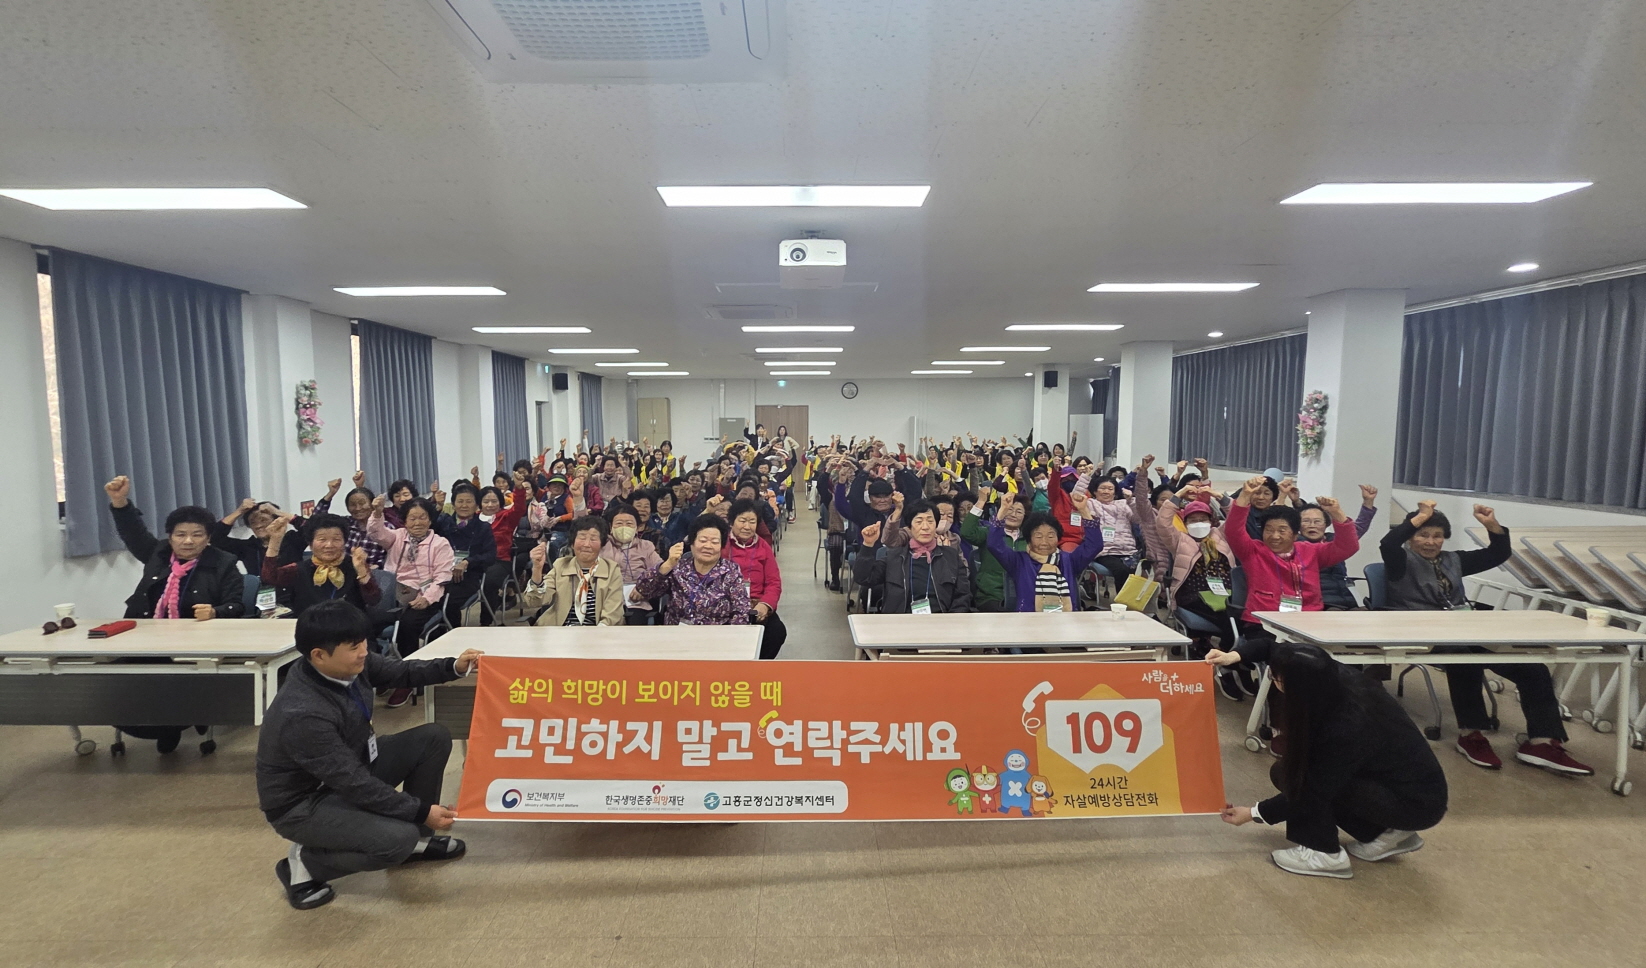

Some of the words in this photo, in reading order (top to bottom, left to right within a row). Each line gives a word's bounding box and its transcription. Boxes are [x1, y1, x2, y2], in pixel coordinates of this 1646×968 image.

[1141, 669, 1168, 684] 사람을
[508, 677, 553, 704] 삶의
[561, 679, 627, 706] 희망이
[634, 680, 701, 706] 보이지
[710, 681, 753, 708] 않을
[760, 681, 782, 706] 때
[1159, 679, 1205, 696] 더하세요
[1066, 710, 1143, 754] 109
[494, 717, 662, 764] 고민하지
[676, 719, 754, 767] 말고
[765, 719, 961, 767] 연락주세요
[1089, 775, 1129, 790] 24시간
[526, 792, 566, 802] 보건복지부
[605, 795, 685, 807] 한국생명존중희망재단
[722, 795, 835, 807] 고흥군정신건강복지센터
[1063, 792, 1159, 809] 자살예방상담전화
